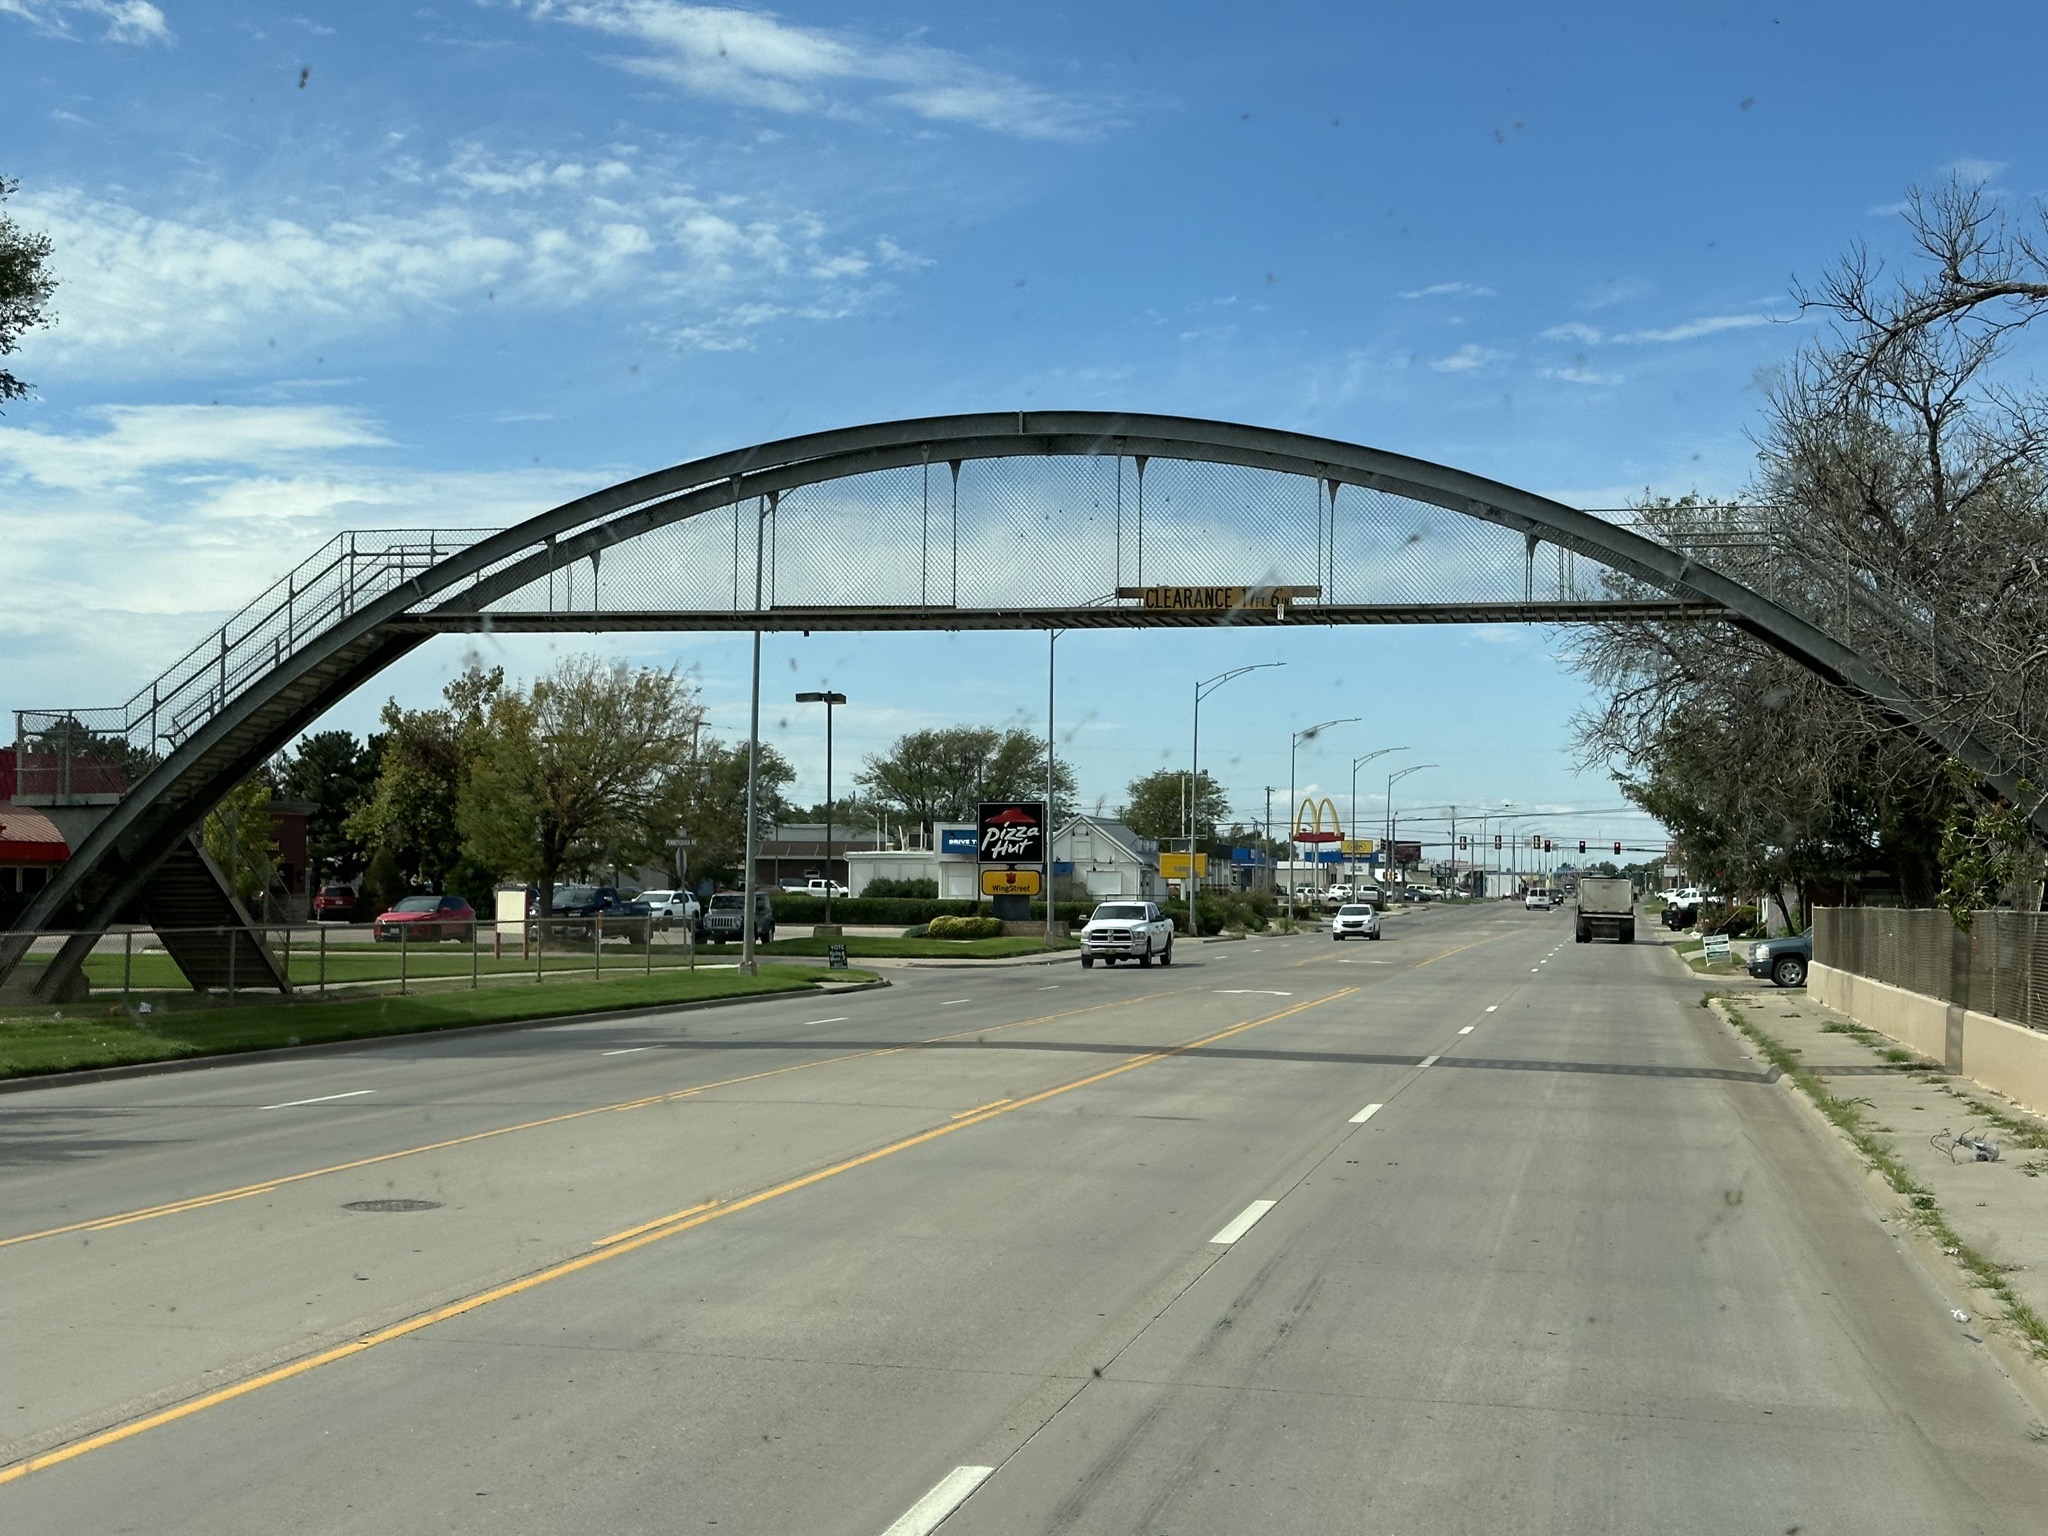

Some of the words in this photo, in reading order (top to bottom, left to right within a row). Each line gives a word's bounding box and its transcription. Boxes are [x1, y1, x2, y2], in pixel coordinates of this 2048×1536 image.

[1146, 588, 1233, 609] CLEARANCE
[991, 838, 1033, 859] Hut
[992, 884, 1031, 894] WingStreet
